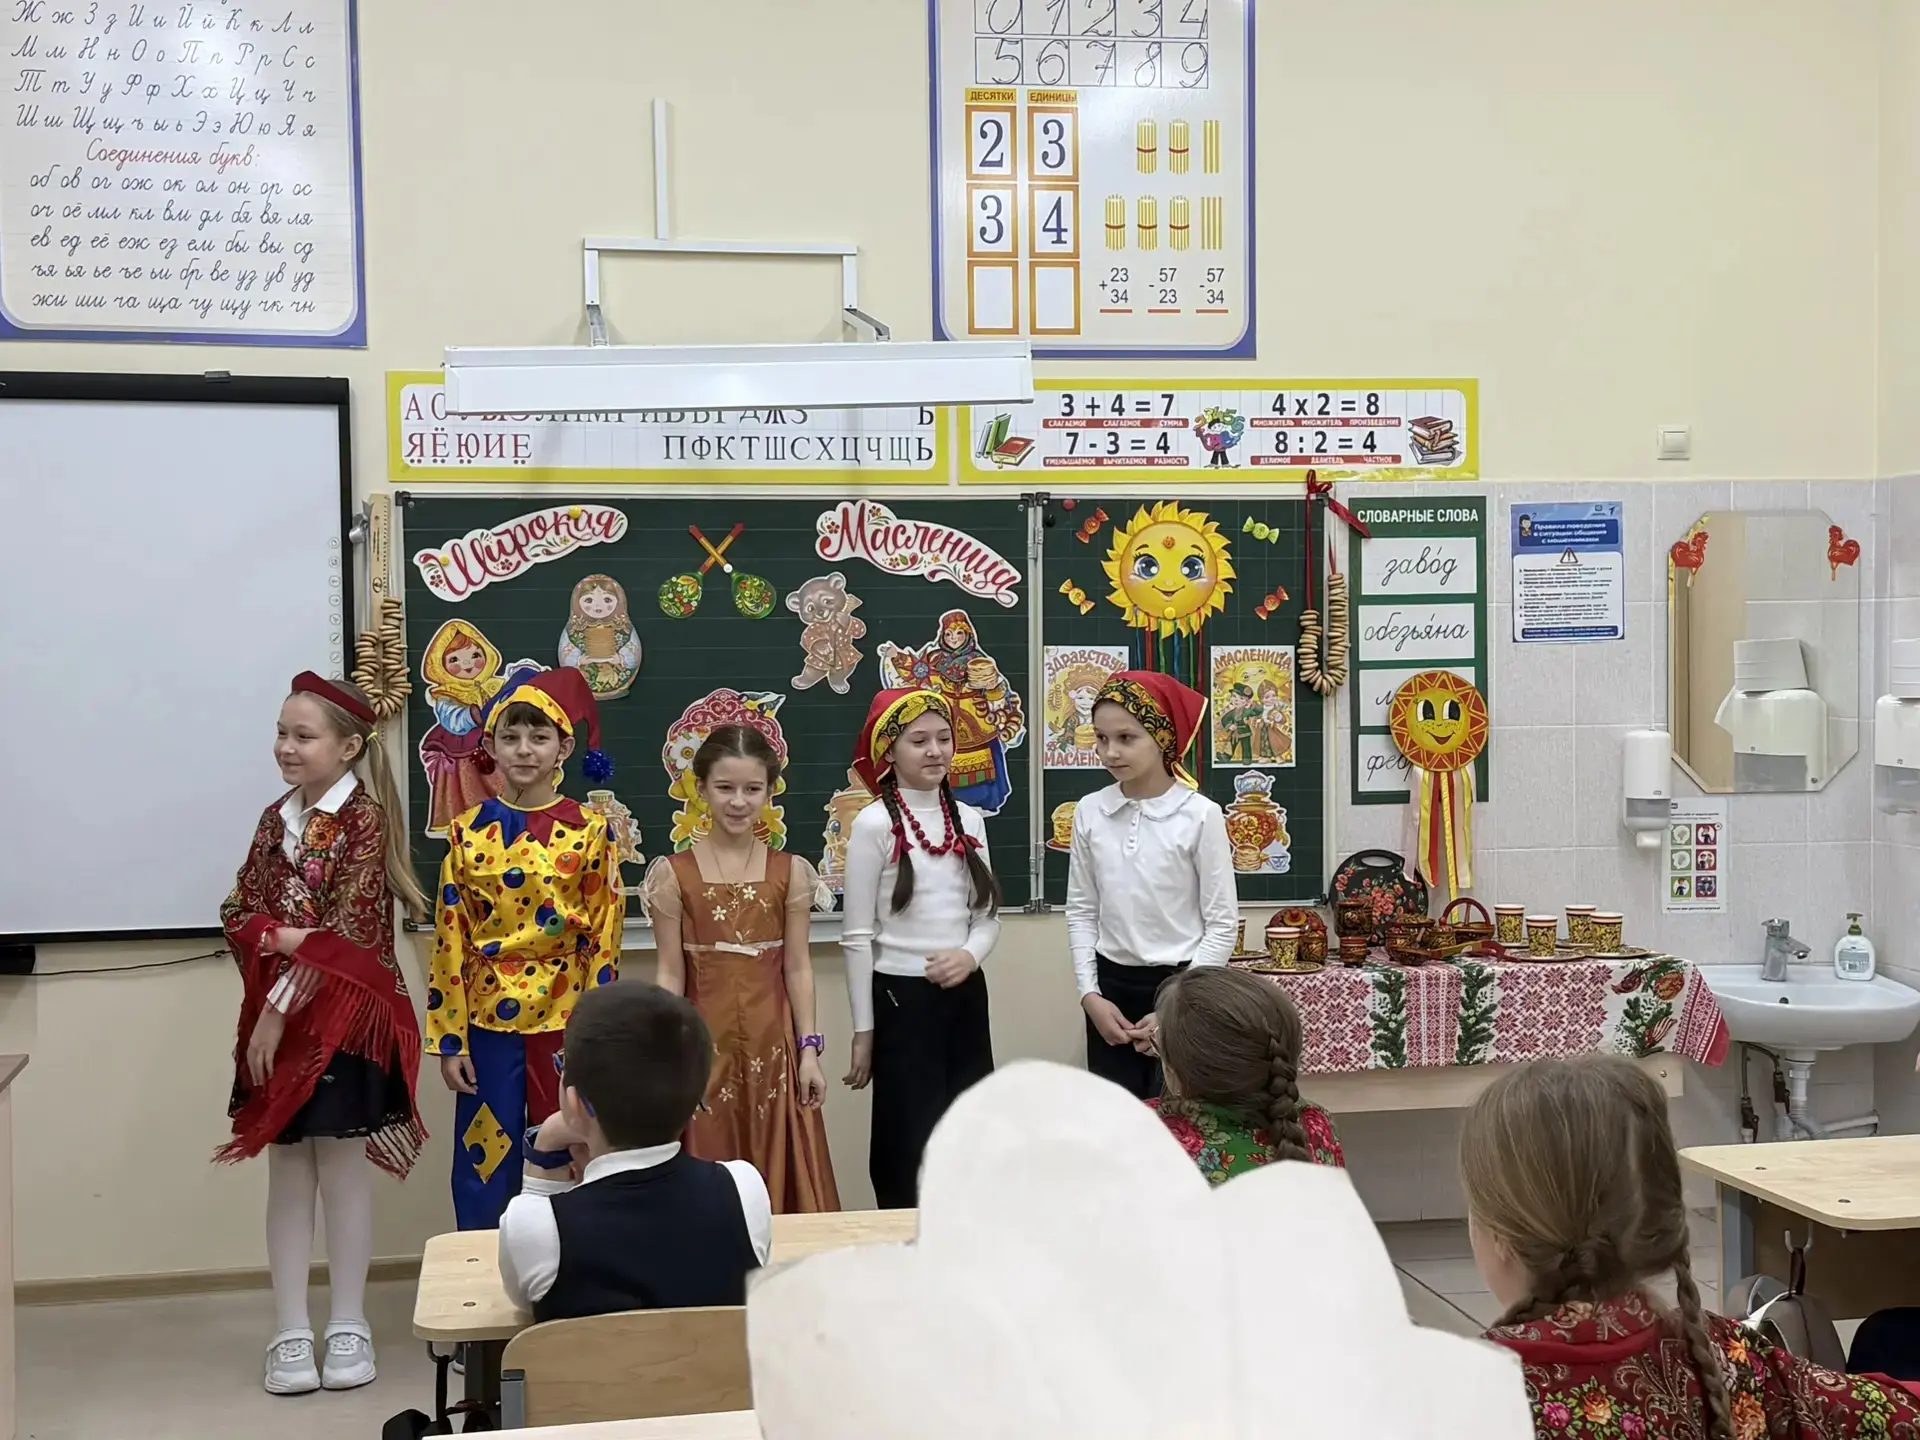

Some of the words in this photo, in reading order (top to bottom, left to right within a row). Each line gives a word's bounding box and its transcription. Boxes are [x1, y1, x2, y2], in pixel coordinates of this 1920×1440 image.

[992, 38, 1021, 85] 5
[1037, 40, 1068, 85] 6
[1135, 41, 1160, 87] 8
[1179, 42, 1208, 88] 9
[970, 92, 1014, 102] ДЕСЯТКИ
[1030, 92, 1077, 103] ЕДИНИЦЫ
[979, 119, 1004, 167] 2
[1041, 119, 1066, 168] 3
[87, 138, 201, 171] Соединения
[30, 164, 60, 187] об
[61, 166, 82, 188] ов
[91, 177, 112, 189] ог
[121, 178, 153, 190] ож
[163, 179, 186, 192] ок
[196, 180, 218, 192] ол
[228, 181, 250, 194] он
[261, 183, 283, 205] ор
[293, 184, 312, 196] ос
[979, 194, 1004, 244] 3
[1042, 196, 1068, 245] 4
[1110, 267, 1129, 283] 23
[1159, 267, 1177, 282] 57
[1207, 267, 1224, 282] 57
[1110, 289, 1129, 304] 34
[1159, 289, 1178, 304] 23
[1207, 289, 1225, 304] 34
[1048, 420, 1087, 428] СЛАГАЕМОЕ
[1103, 420, 1141, 428] СЛАГАЕМОЕ
[1159, 420, 1183, 428] СУММА
[1253, 419, 1295, 427] МНОЖИТЕЛЬ
[1301, 419, 1342, 427] МНОЖИТЕЛЬ
[1350, 419, 1400, 427] ПРОИЗВЕДЕНИЕ
[1045, 458, 1096, 466] УМЕНЬШАЕМОЕ
[1357, 509, 1434, 523] СЛОВАРНЫЕ
[1436, 508, 1479, 522] СЛОВА
[420, 509, 616, 595] Широкая
[820, 502, 1017, 605] Масленица
[1214, 649, 1293, 670] МАСЛЕНИЦА
